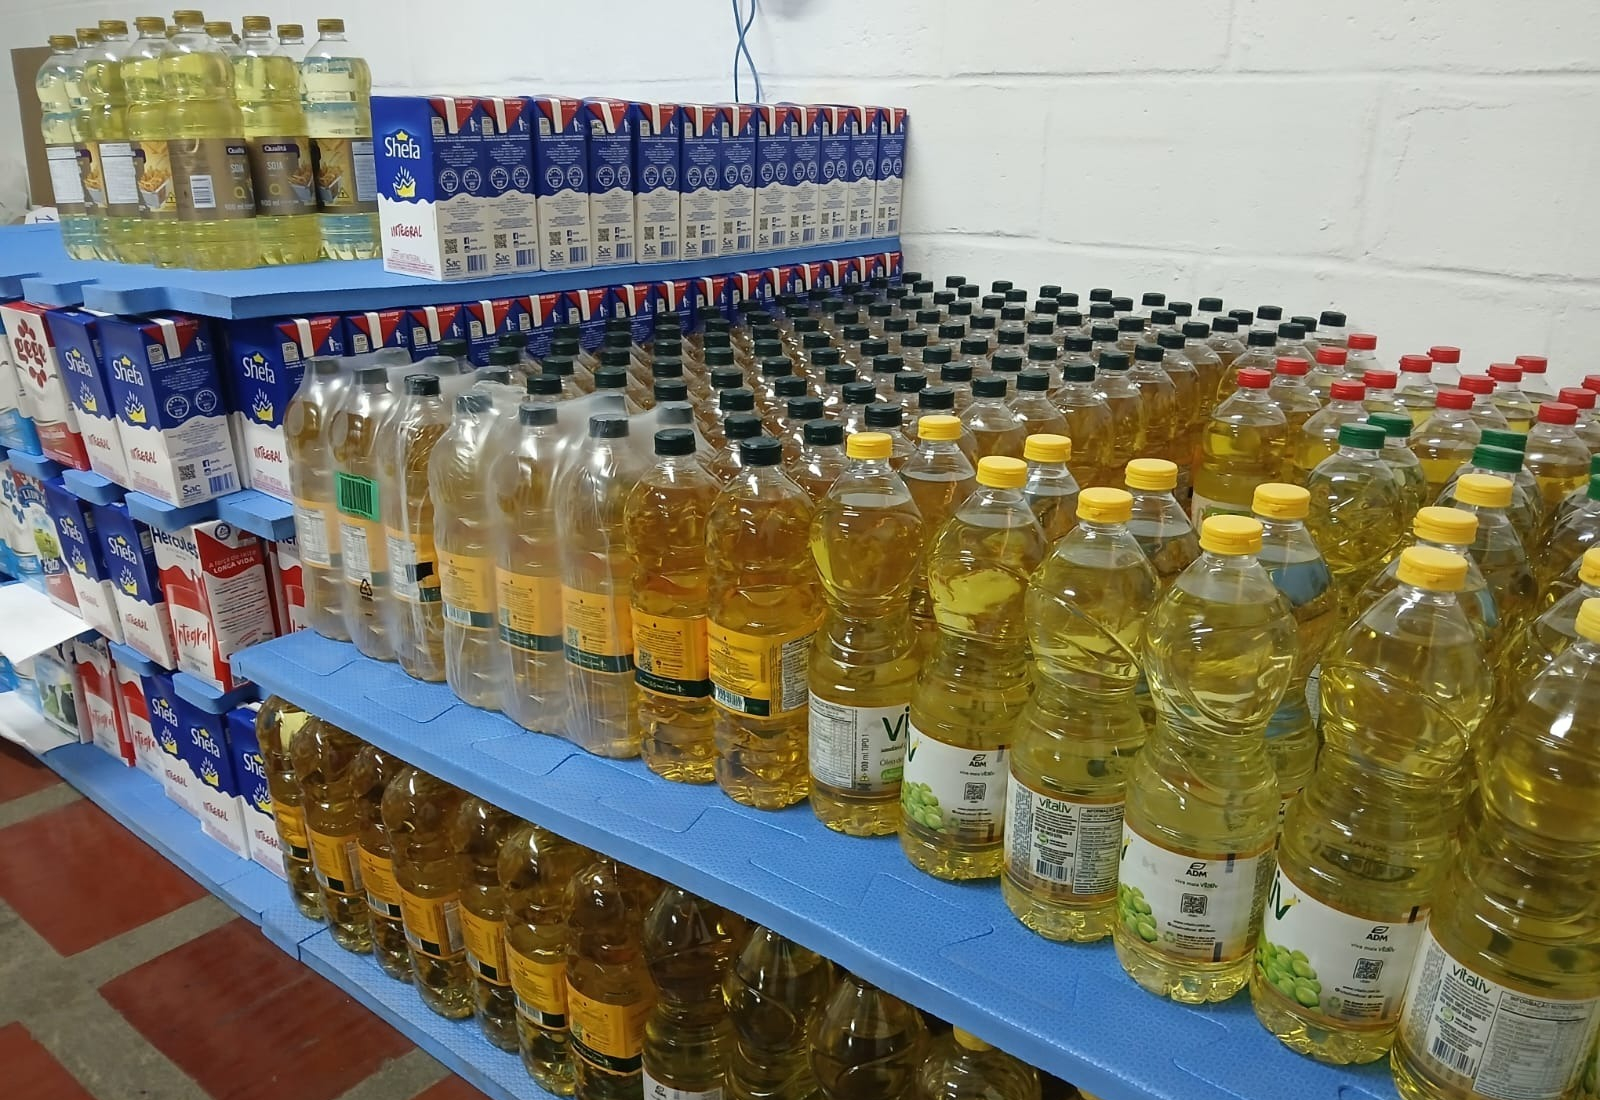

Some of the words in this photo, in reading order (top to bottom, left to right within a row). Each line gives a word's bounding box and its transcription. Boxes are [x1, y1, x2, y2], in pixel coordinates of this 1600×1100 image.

[384, 136, 421, 160] Shefa
[391, 223, 422, 238] INTEGRAL
[14, 337, 47, 368] gege
[65, 351, 94, 378] Shefa
[112, 359, 144, 387] Shefa
[243, 358, 276, 385] Shefa
[88, 434, 111, 451] INTEGRAL
[130, 447, 157, 464] INTEGRAL
[253, 447, 282, 464] INTEGRAL
[182, 483, 201, 493] Sac
[59, 517, 84, 544] Shefa
[108, 537, 138, 565] Shefa
[152, 527, 199, 559] Hercules
[237, 557, 255, 567] VIDA
[125, 613, 149, 631] INTEGRAL
[174, 619, 211, 650] Integral
[152, 698, 178, 727] Shefa
[191, 728, 221, 758] Shefa
[861, 737, 870, 750] TIPO
[968, 760, 987, 768] ADM
[203, 801, 229, 822] INTEGRAL
[1185, 869, 1208, 878] ADM
[1366, 933, 1388, 942] ADM
